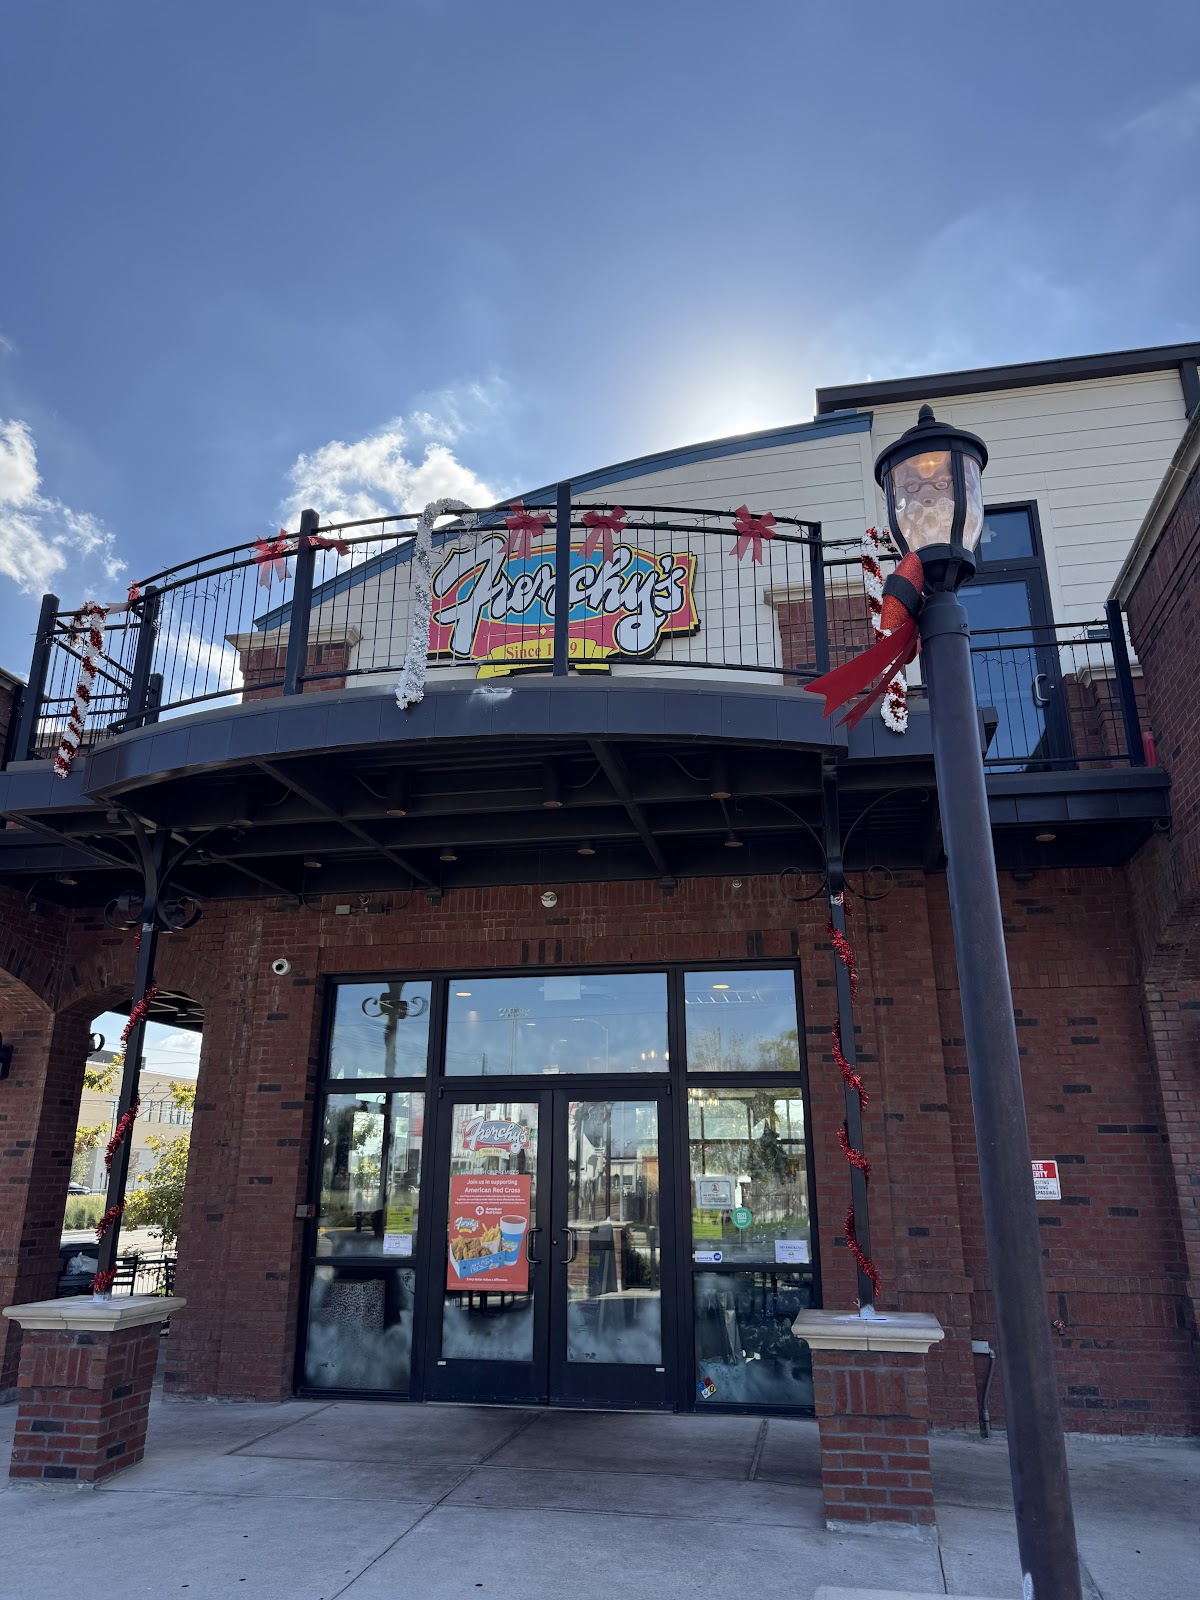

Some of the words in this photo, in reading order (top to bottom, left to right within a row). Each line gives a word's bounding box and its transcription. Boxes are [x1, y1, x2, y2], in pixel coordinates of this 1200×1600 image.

[432, 533, 687, 655] Frenchy's
[505, 645, 541, 659] Since
[546, 641, 578, 656] 19
[465, 1116, 528, 1155] Frenchy's
